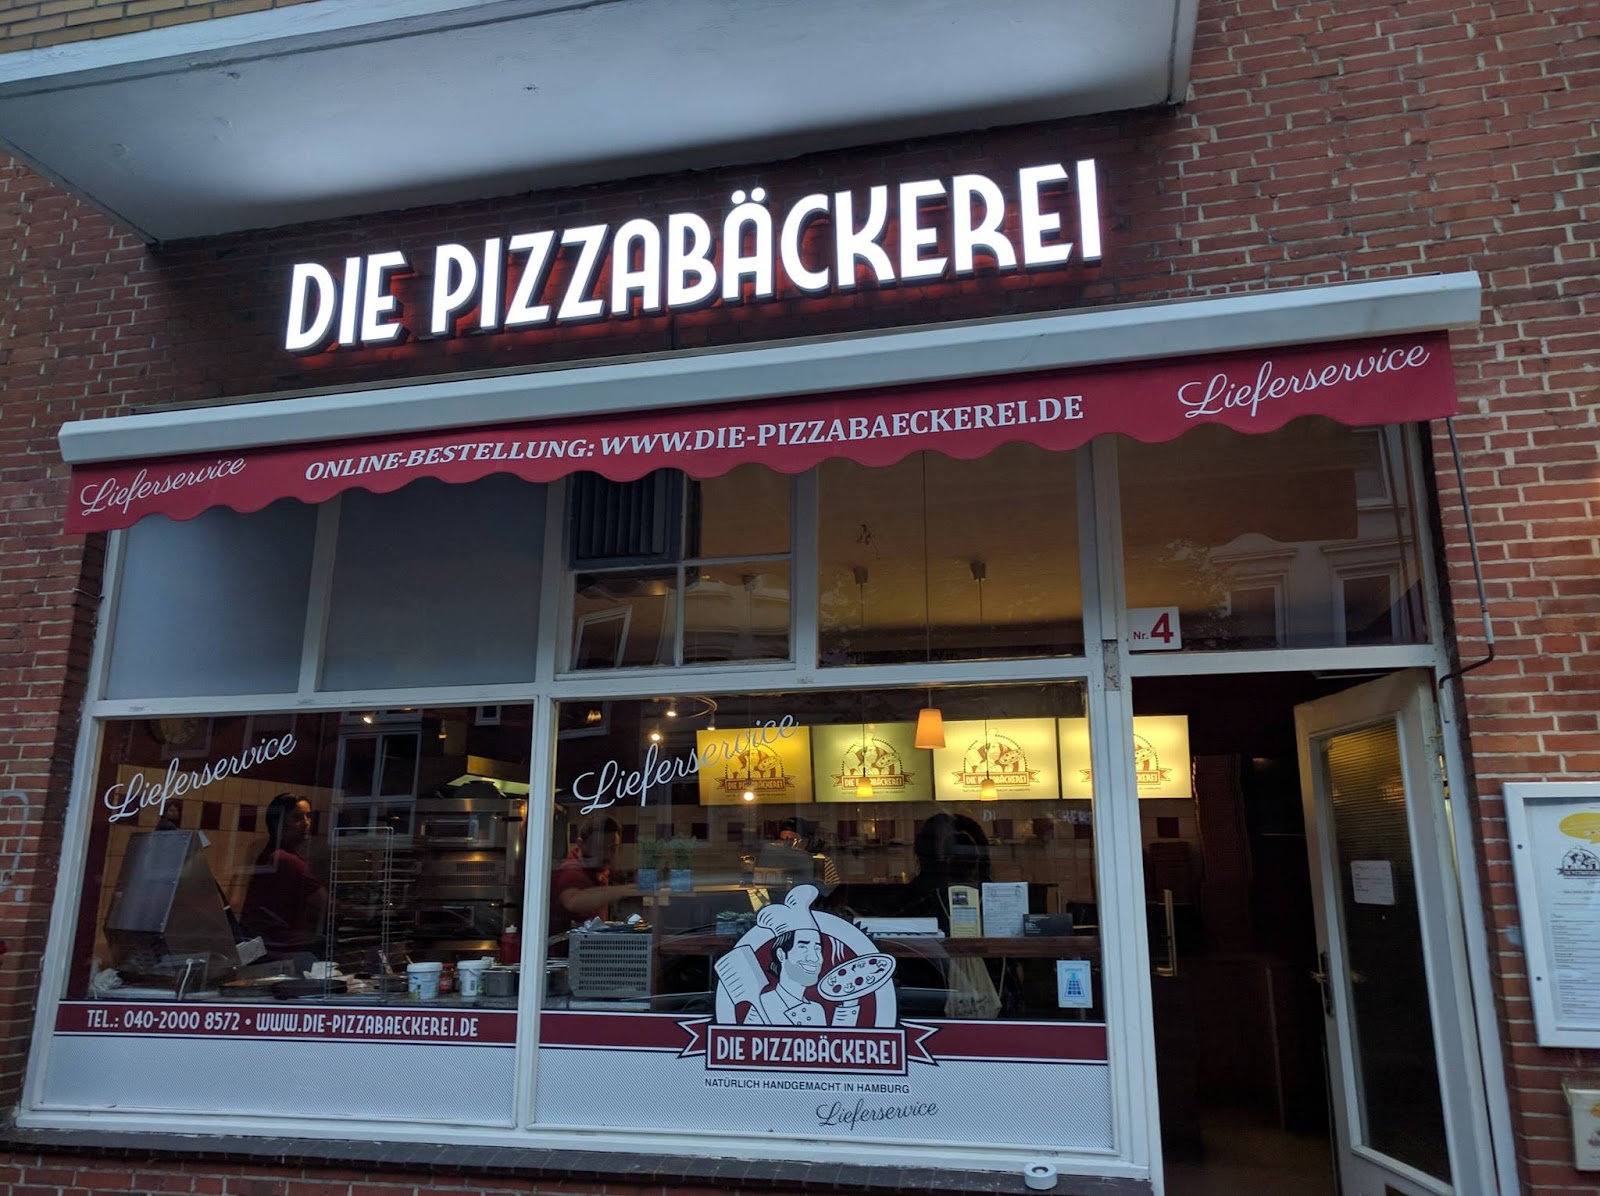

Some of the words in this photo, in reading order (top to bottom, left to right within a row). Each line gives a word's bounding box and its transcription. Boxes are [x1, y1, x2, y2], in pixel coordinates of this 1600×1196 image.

[285, 251, 406, 351] DIE
[431, 158, 1101, 335] PIZZABÄCKEREI
[1177, 344, 1430, 418] Lieferservice
[305, 438, 595, 482] ONLINE-BESTELLUNG:
[600, 395, 1084, 456] WWW.DIE-PIZZABAECKEREI.DE
[80, 456, 246, 517] Lieferservice
[1133, 631, 1149, 640] Nr.
[1150, 612, 1174, 643] 4
[104, 731, 297, 822] Lieferservice
[573, 714, 799, 815] Lieferservice
[87, 1009, 119, 1028] TEL.:
[123, 1010, 200, 1029] 040-2000
[204, 1011, 240, 1031] 8572
[256, 1012, 479, 1037] WWW.DIE-PIZZABAECKEREI.DE
[716, 1036, 745, 1060] DIE
[752, 1035, 897, 1065] PIZZABÄCKEREI
[705, 1076, 760, 1089] NATÜRLICH
[763, 1079, 841, 1092] HANDGEMACHT
[844, 1082, 855, 1092] IN
[857, 1082, 910, 1094] HAMBURG
[816, 1098, 939, 1131] Lieferservice
